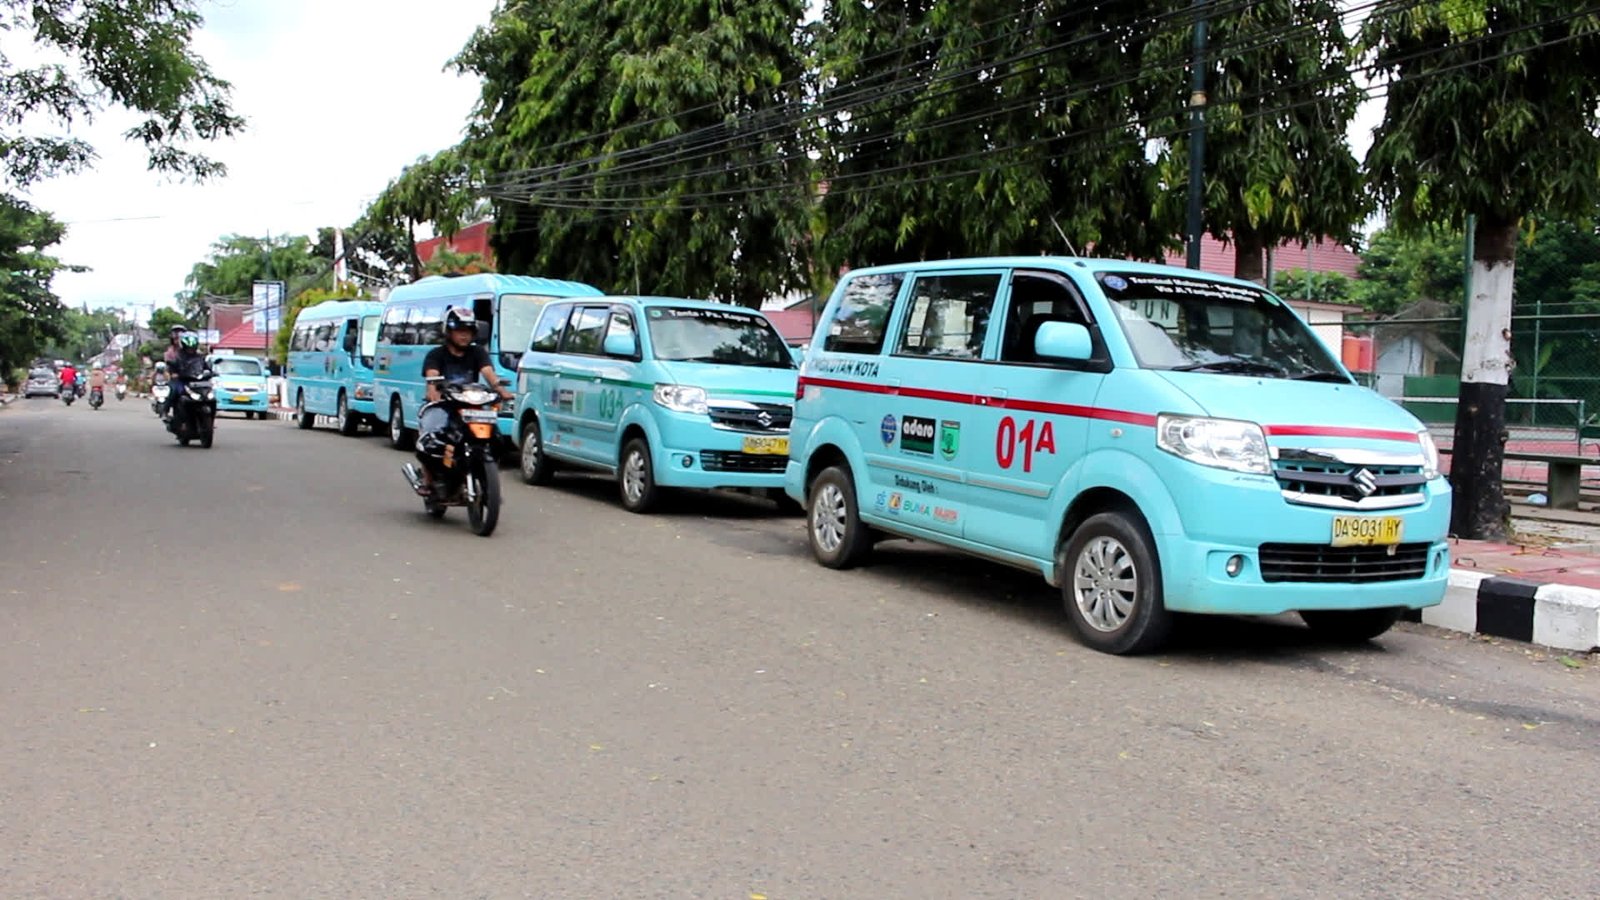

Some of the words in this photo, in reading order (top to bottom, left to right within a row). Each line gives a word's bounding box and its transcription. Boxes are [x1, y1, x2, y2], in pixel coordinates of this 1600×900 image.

[854, 361, 880, 377] KOTA
[600, 388, 623, 419] 03A
[903, 419, 934, 438] adaro
[996, 415, 1056, 473] 01A
[1335, 518, 1348, 537] DA
[1352, 519, 1382, 538] 9031
[1386, 519, 1402, 537] HY
